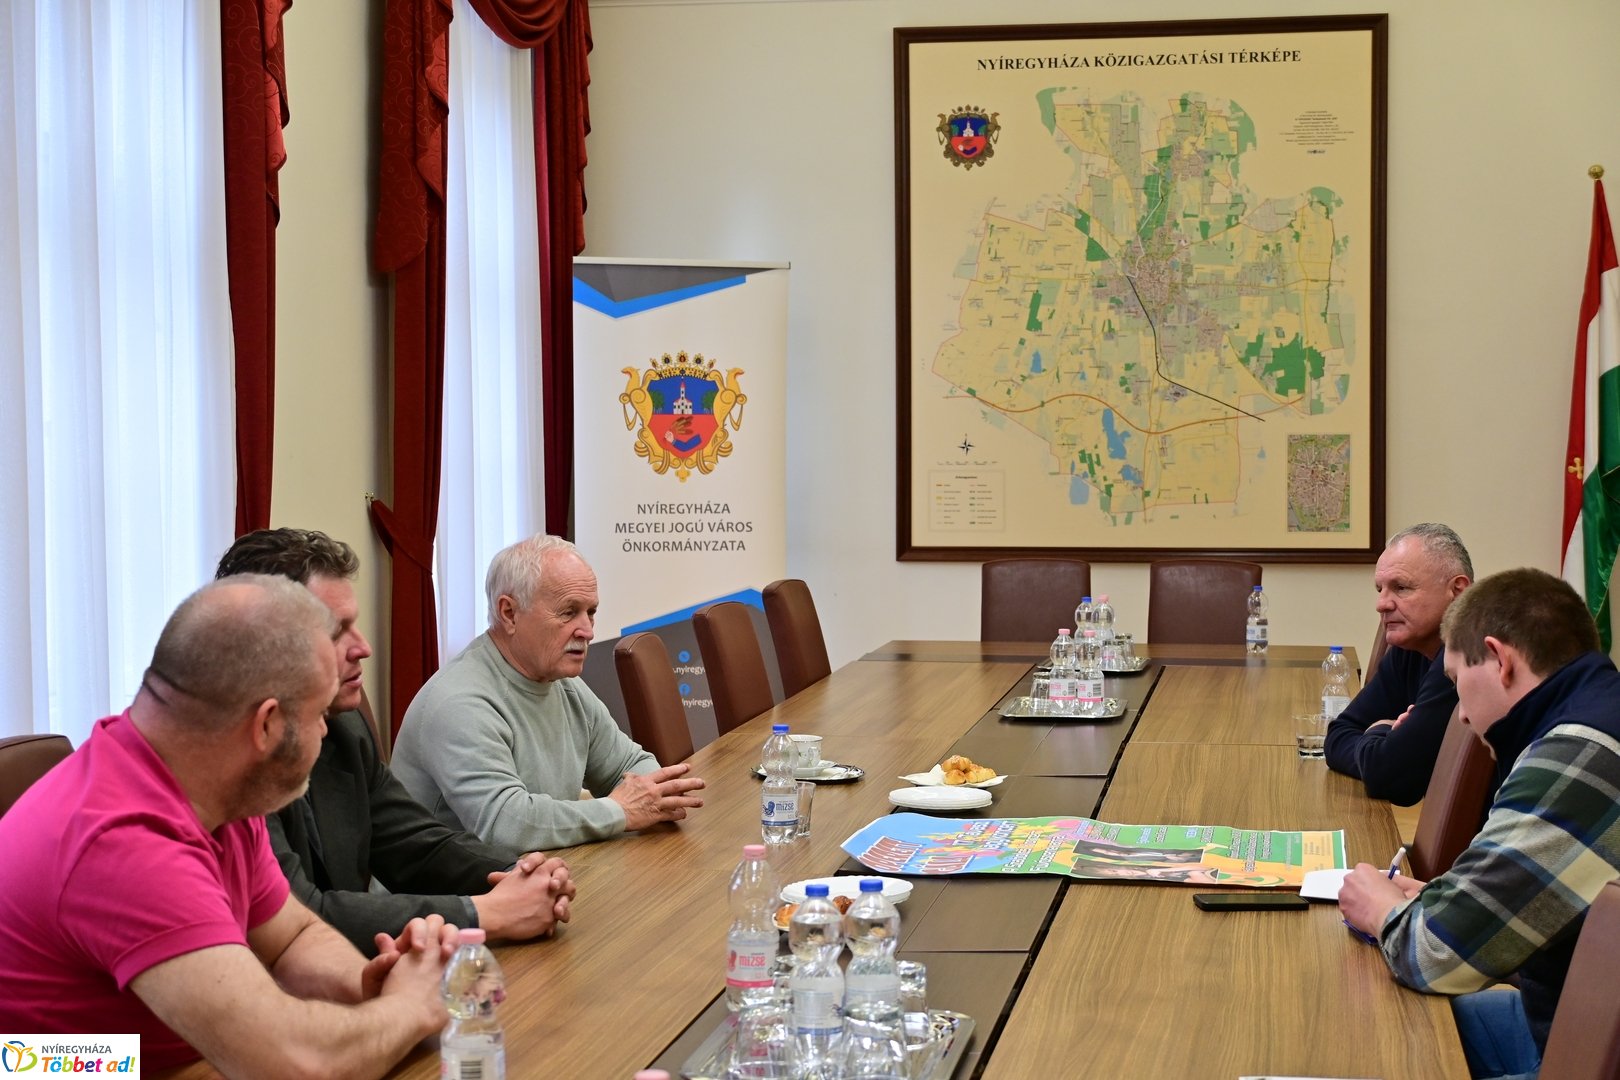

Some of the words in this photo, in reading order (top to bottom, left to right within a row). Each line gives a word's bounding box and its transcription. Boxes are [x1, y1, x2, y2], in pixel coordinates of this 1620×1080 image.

[977, 54, 1090, 71] NYÍREGYHÁZA
[1094, 50, 1223, 67] KÖZIGAZGATÁSI
[1228, 48, 1301, 64] TÉRKÉPE
[637, 500, 731, 515] NYÍREGYHÁZA
[614, 522, 665, 534] MEGYEI
[668, 519, 704, 534] JOGÚ
[707, 519, 753, 533] VÁROS
[622, 538, 746, 553] ÖNKORMÁNYZATA
